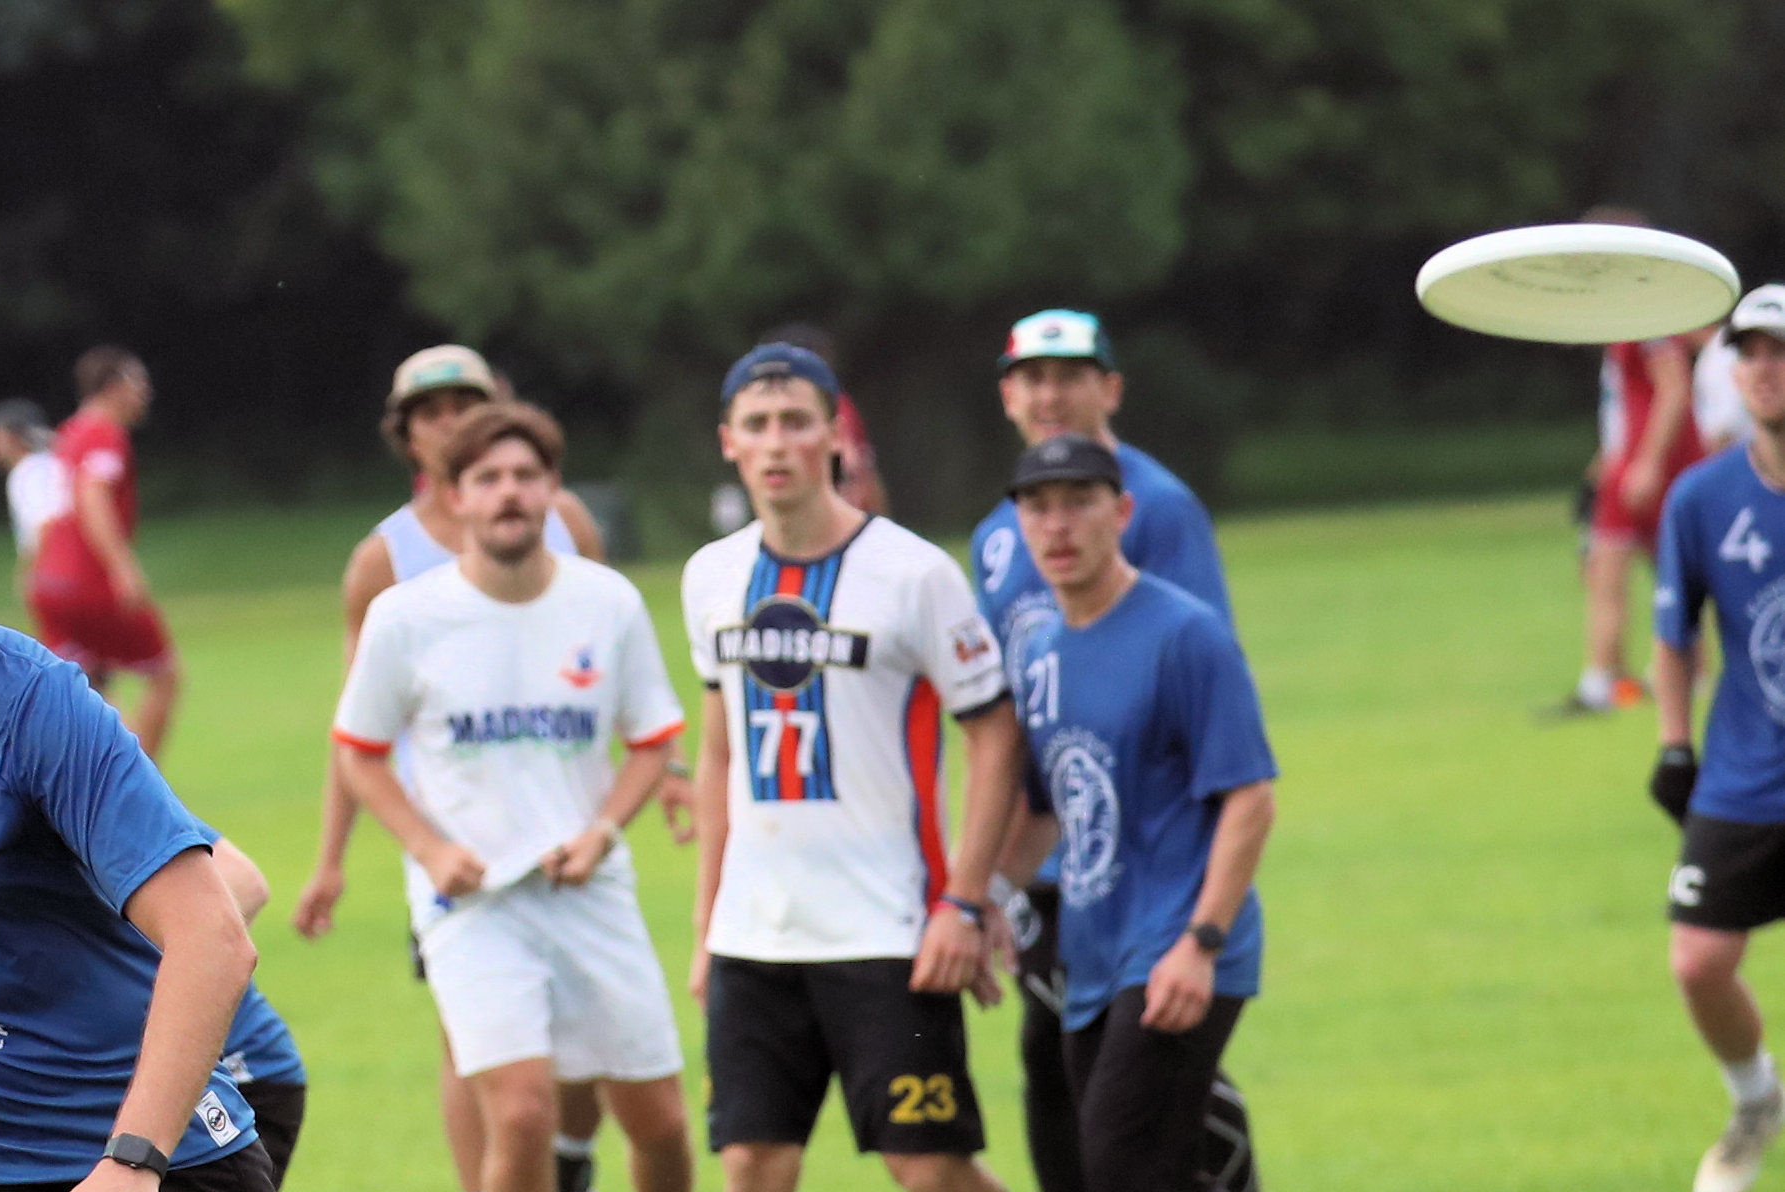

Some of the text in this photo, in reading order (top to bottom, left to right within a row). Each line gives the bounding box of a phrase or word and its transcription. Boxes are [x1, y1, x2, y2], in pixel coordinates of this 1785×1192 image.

[982, 526, 1015, 594] 9
[1718, 506, 1772, 573] 4
[718, 627, 854, 668] MADISON
[447, 705, 598, 744] MADISON
[749, 709, 820, 776] 77
[888, 1073, 957, 1124] 23
